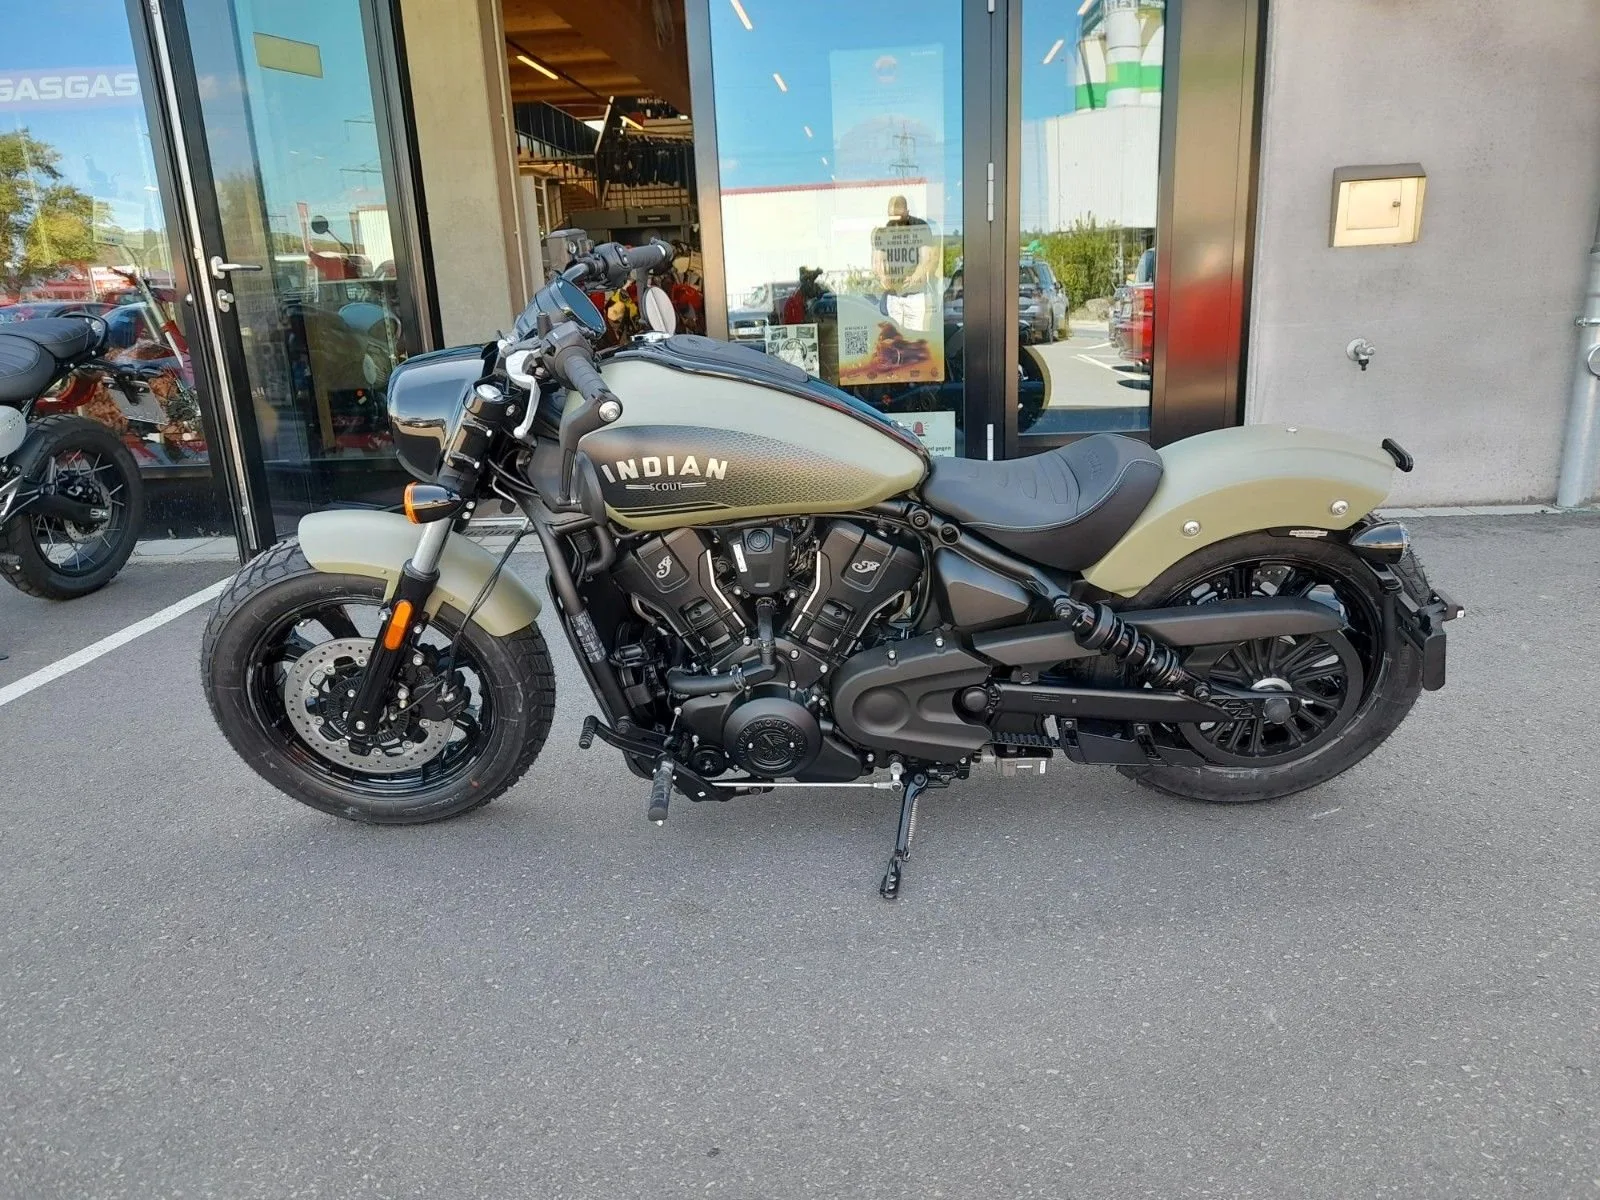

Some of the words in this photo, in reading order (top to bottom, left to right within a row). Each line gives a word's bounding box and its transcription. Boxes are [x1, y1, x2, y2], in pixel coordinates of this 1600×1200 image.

[0, 72, 139, 102] GASGAS
[880, 247, 919, 264] HURC
[601, 455, 728, 483] INDIAN
[649, 482, 683, 492] SCOUT
